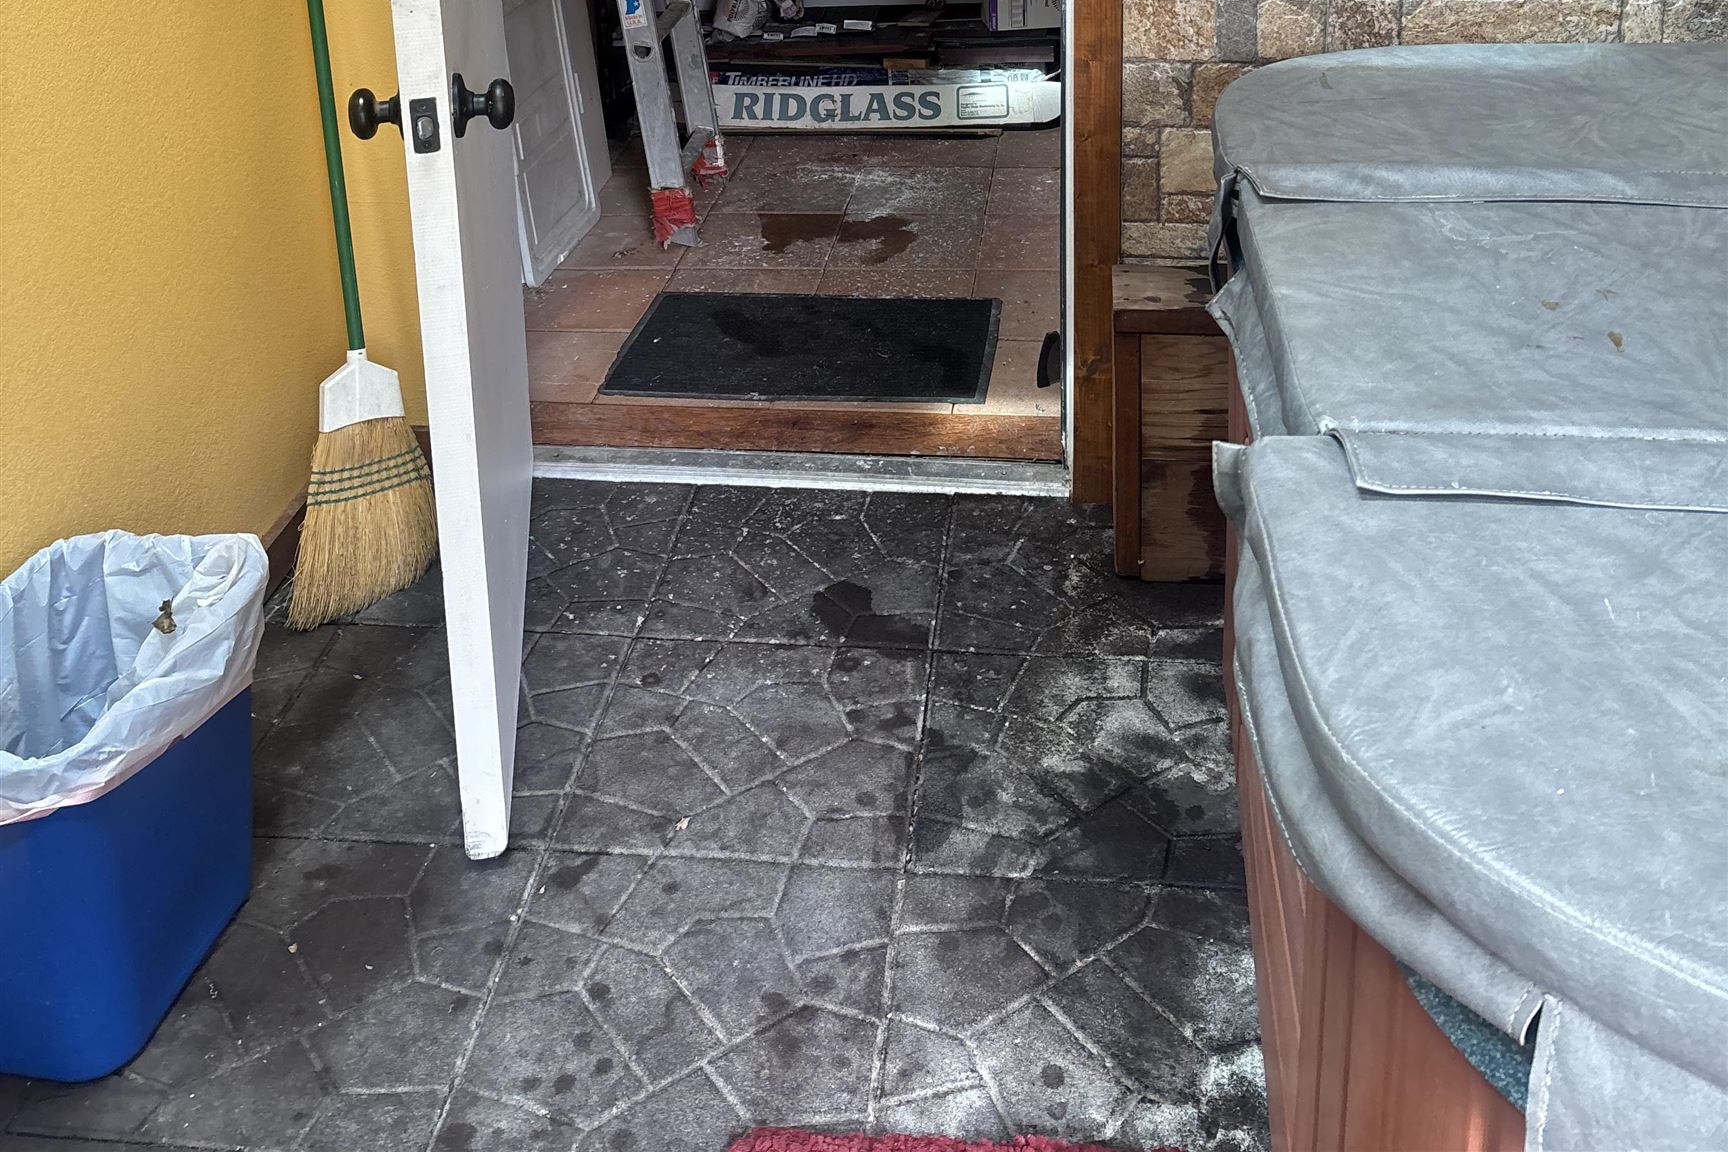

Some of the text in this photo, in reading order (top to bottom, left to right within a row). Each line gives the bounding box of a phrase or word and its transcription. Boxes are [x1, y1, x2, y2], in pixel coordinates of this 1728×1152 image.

[724, 71, 829, 87] TIMBERLINE
[829, 73, 858, 87] HD
[731, 91, 942, 123] RIDGLASS
